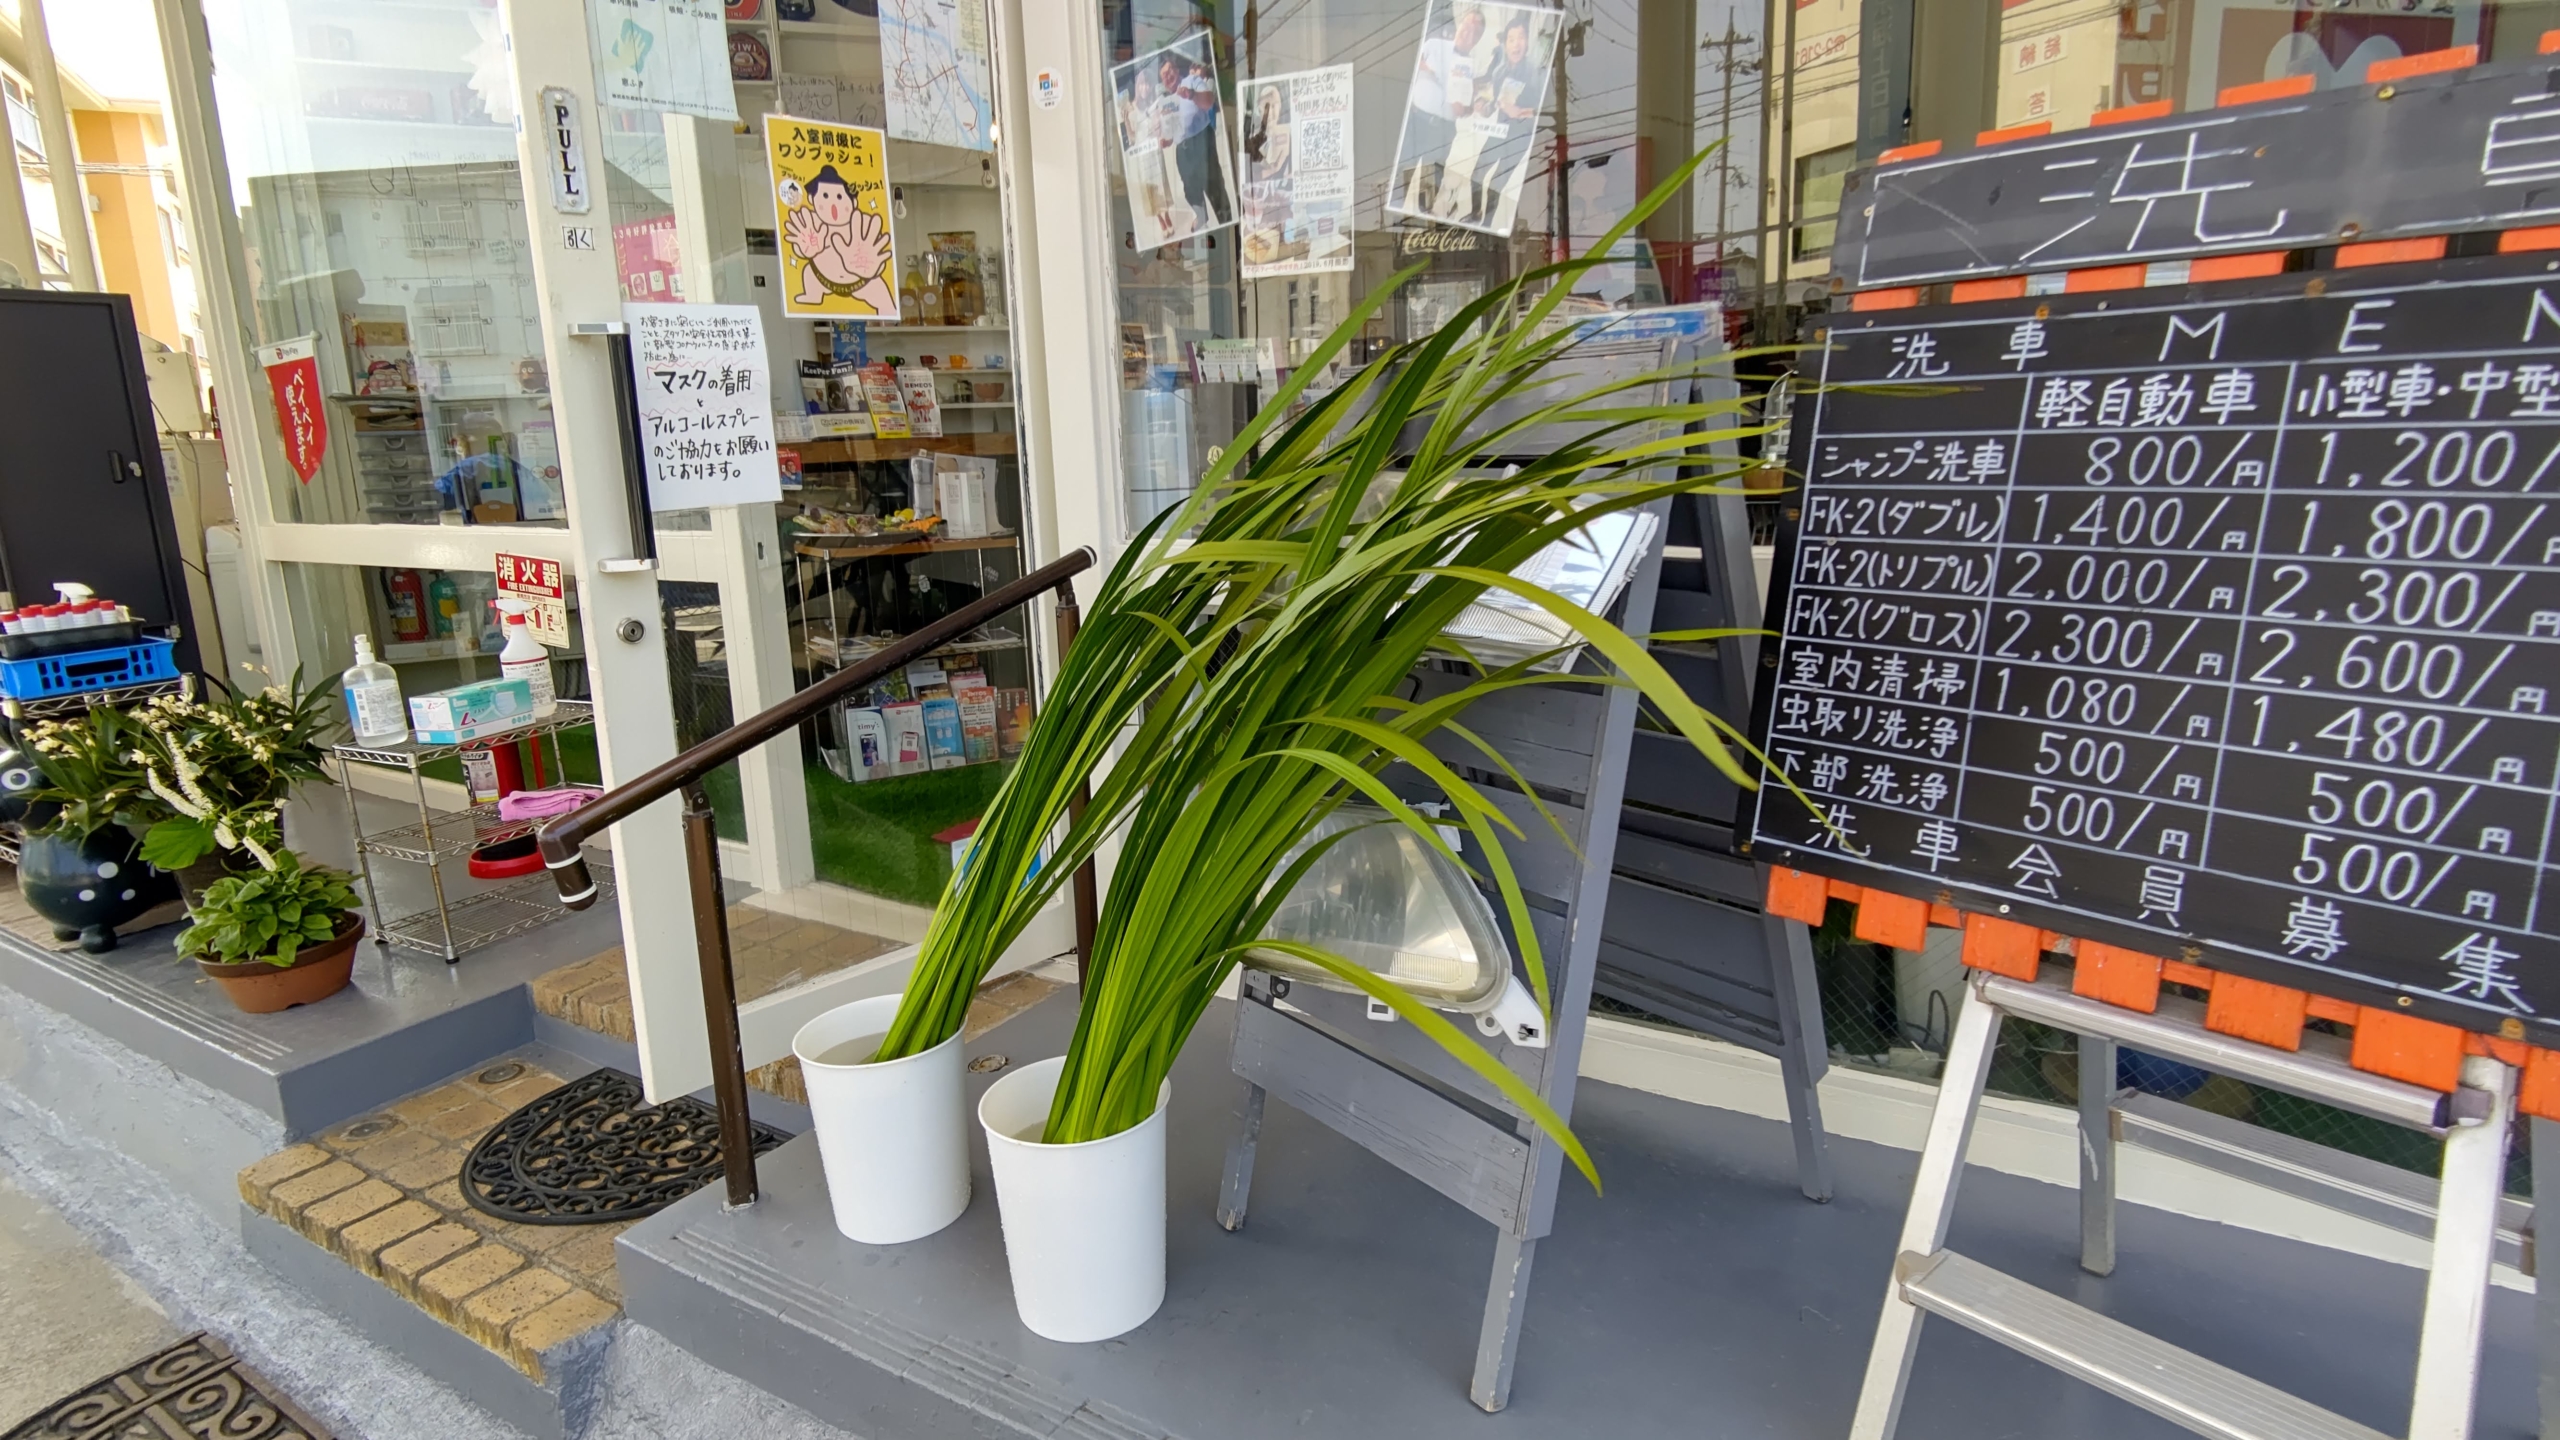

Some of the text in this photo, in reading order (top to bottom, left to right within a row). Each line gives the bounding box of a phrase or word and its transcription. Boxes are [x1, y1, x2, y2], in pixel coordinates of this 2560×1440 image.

[554, 105, 580, 196] PULL
[792, 127, 862, 150] 入室前後に
[567, 230, 591, 249] 引く
[1402, 226, 1479, 255] Coca-Cola
[654, 365, 752, 397] マスクの着用
[2035, 369, 2257, 428] 軽自動車
[293, 368, 314, 446] ペイペイ
[648, 408, 760, 437] アルコールスプレー
[697, 398, 704, 408] と
[285, 384, 308, 470] 使えます。
[654, 435, 770, 461] のご協力をお願い
[1820, 438, 2007, 485] シャンプー洗車
[658, 461, 742, 481] しております。
[1807, 494, 2006, 542] FK-2(ダブル)
[498, 555, 559, 589] 消火器
[507, 581, 519, 591] FIRE
[1800, 546, 1994, 597] FK-2(トリプル)
[1790, 594, 1981, 652] FK-2(グロス)
[1788, 645, 1966, 706] 室内清掃
[857, 722, 876, 731] timy
[1776, 693, 1959, 758] 虫取り洗浄
[1775, 747, 1949, 812] 下部洗浄
